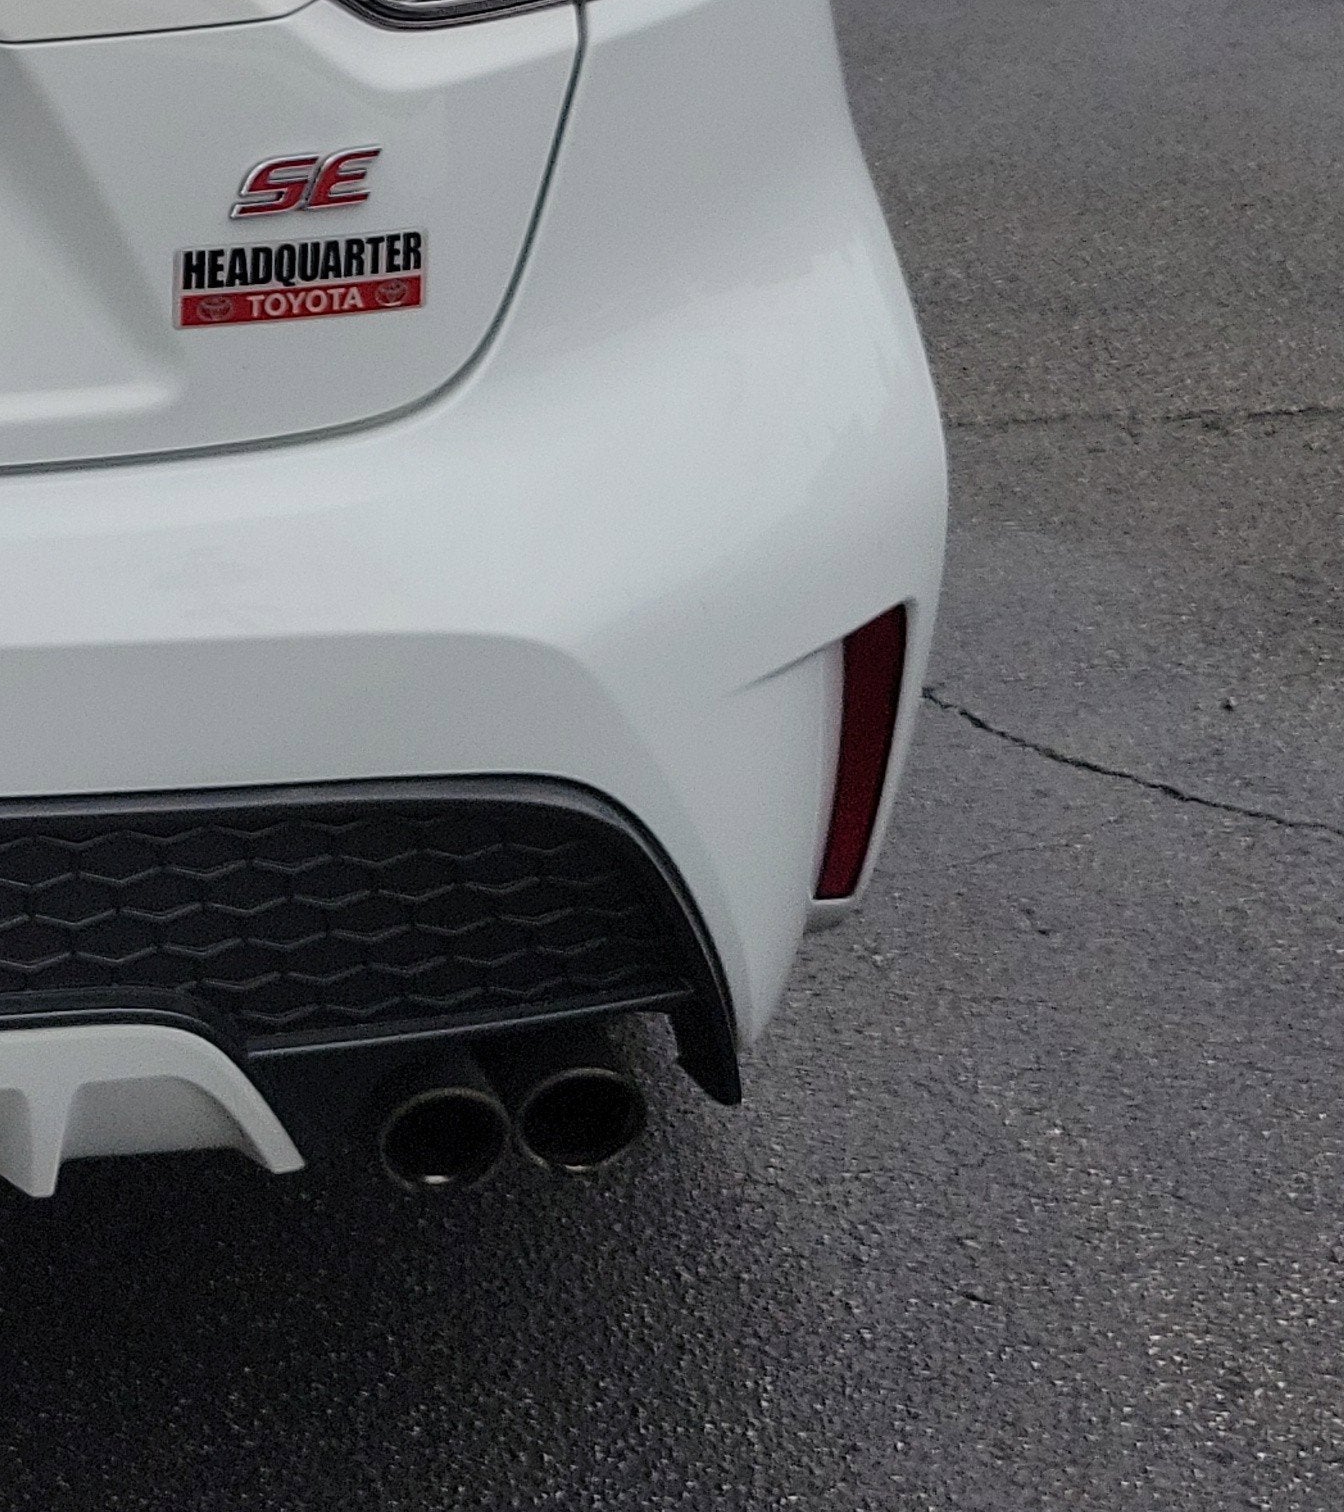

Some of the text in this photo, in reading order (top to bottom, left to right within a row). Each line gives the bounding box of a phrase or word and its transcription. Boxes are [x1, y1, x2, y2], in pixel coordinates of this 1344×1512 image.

[230, 143, 382, 220] SE
[182, 231, 423, 290] HEADQUARTER
[247, 287, 364, 319] TOYOTA
